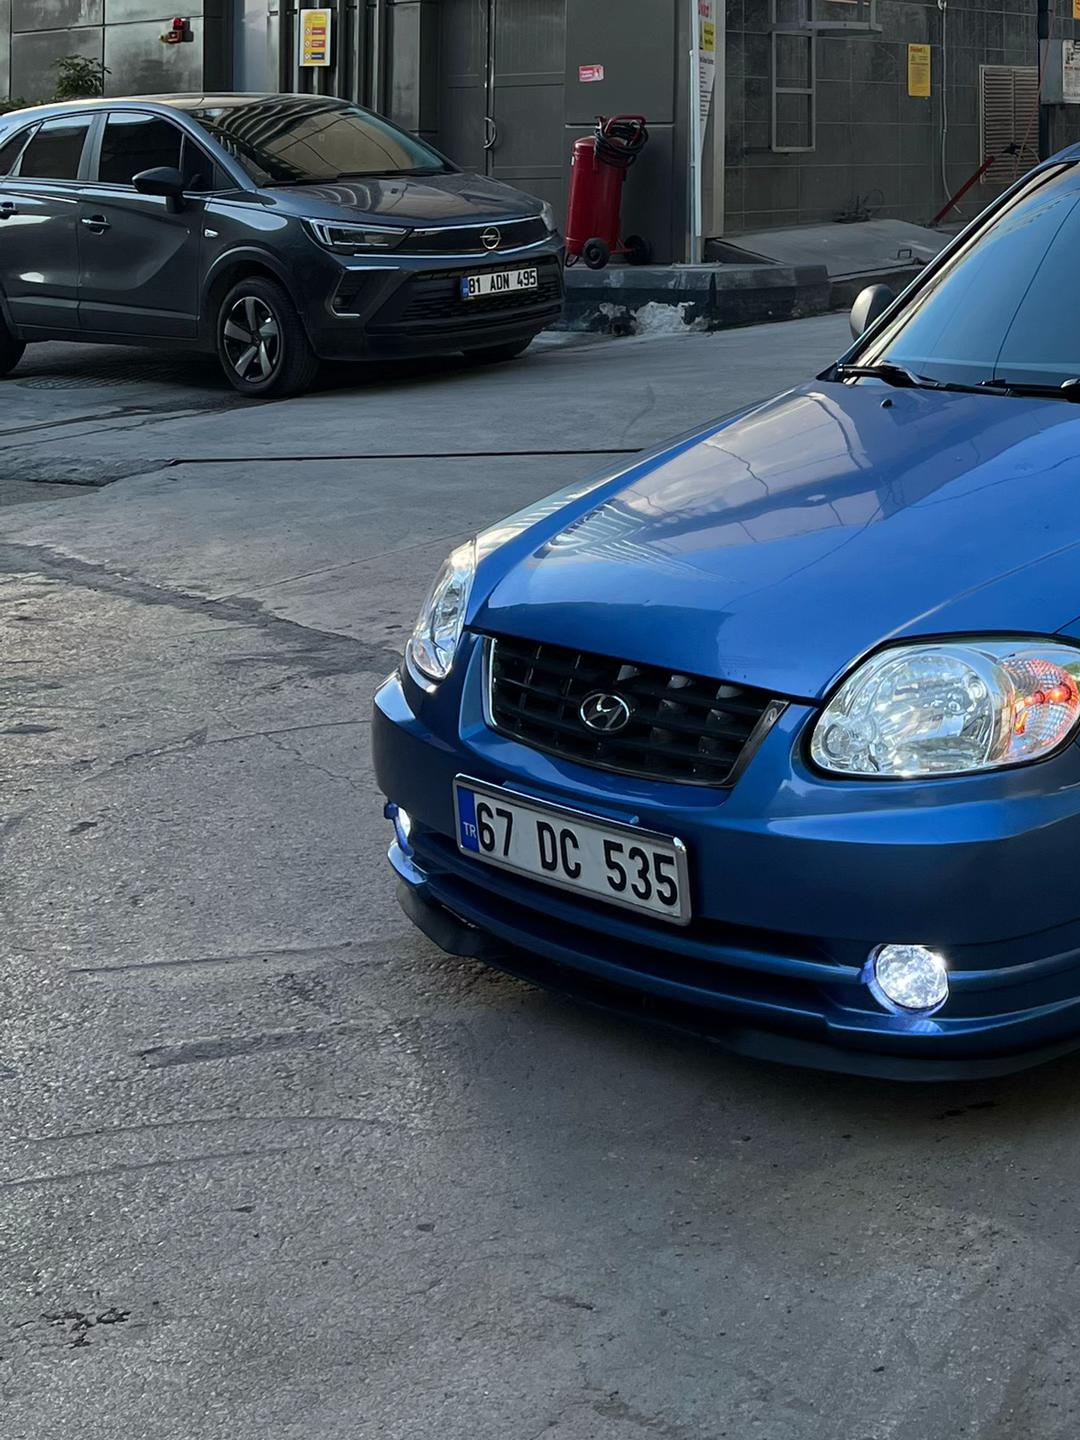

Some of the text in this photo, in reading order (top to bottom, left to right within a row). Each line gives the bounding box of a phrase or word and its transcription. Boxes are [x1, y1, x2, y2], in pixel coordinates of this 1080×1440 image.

[468, 269, 536, 294] 81 ADN 495
[462, 821, 477, 839] TR
[476, 801, 678, 906] 67 DC 535
